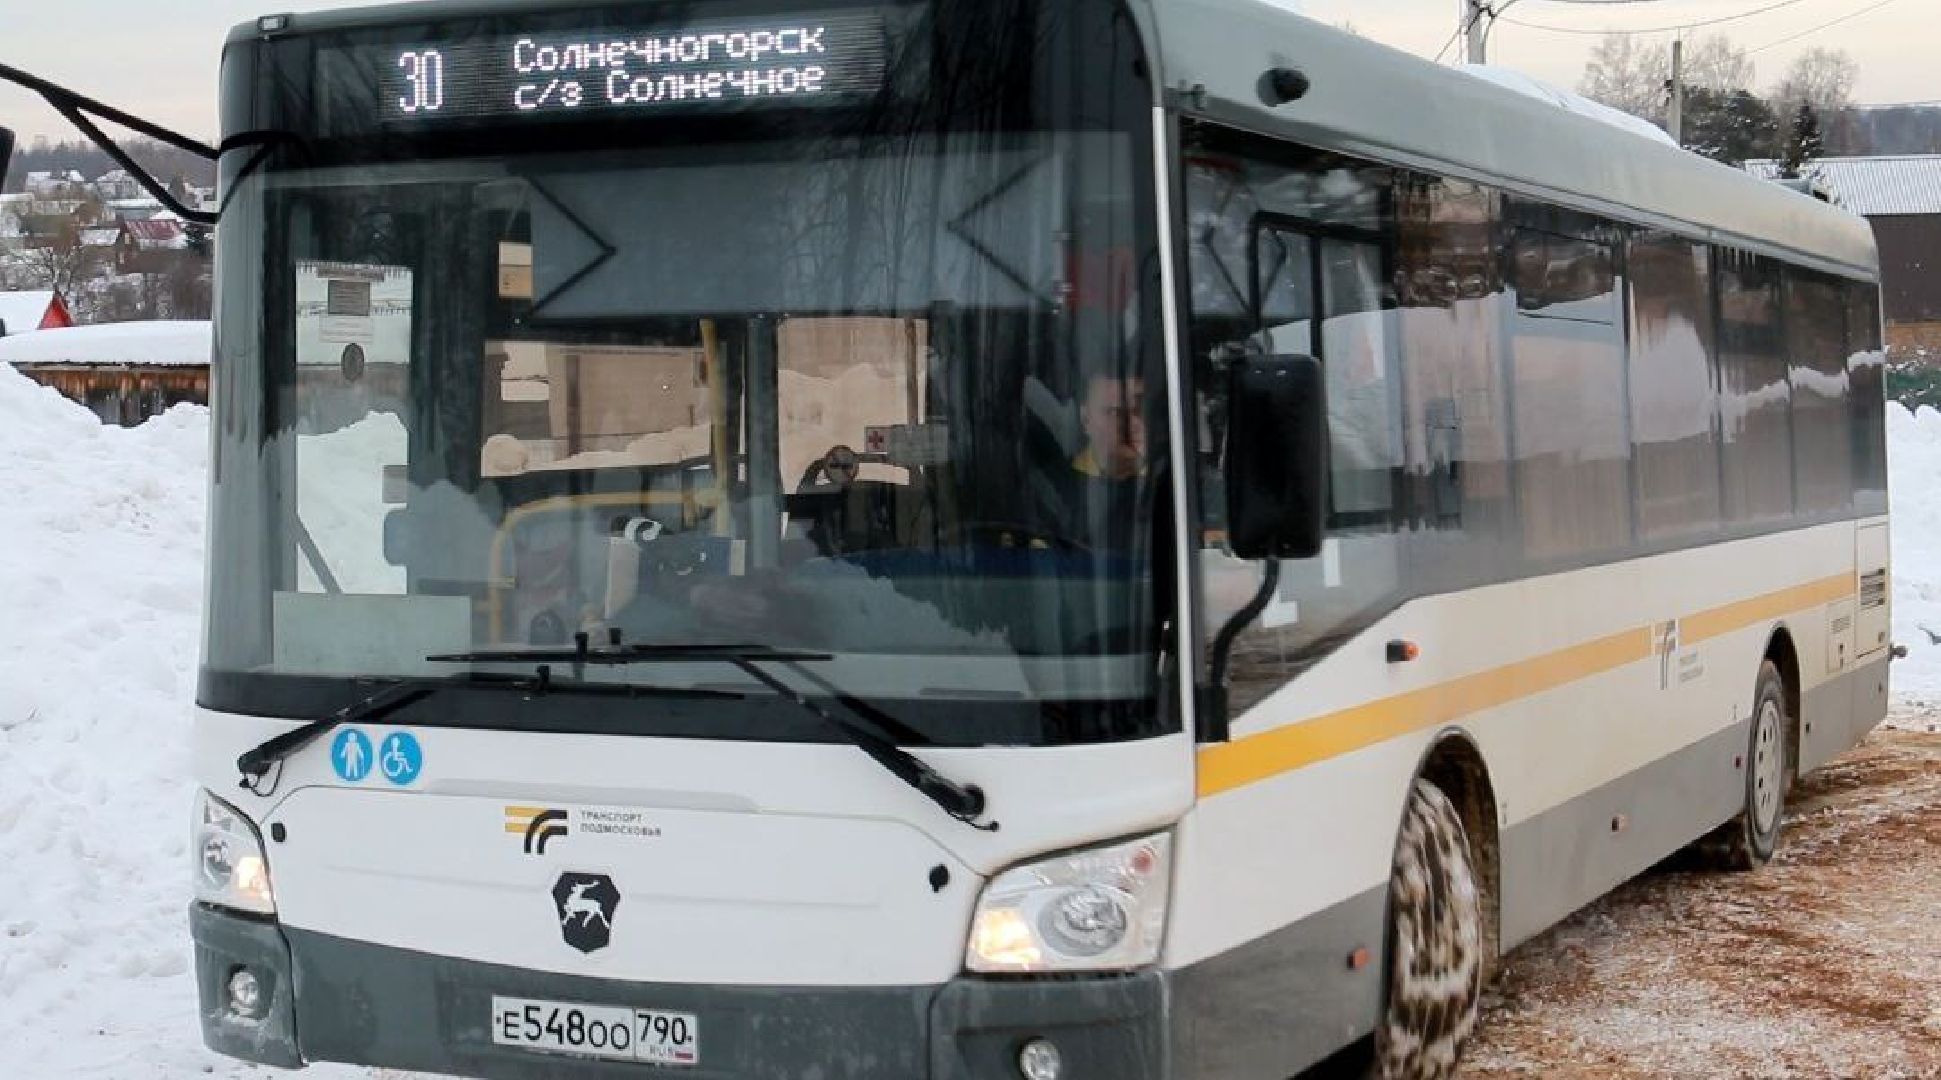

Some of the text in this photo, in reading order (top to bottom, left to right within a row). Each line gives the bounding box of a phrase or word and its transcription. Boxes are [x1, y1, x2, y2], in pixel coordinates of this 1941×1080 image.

[513, 27, 825, 72] Солнечногорск
[399, 50, 443, 112] 30
[513, 65, 827, 110] с/з Солнечное
[581, 810, 642, 823] ТРАНСПОРТ
[637, 1013, 687, 1046] 790
